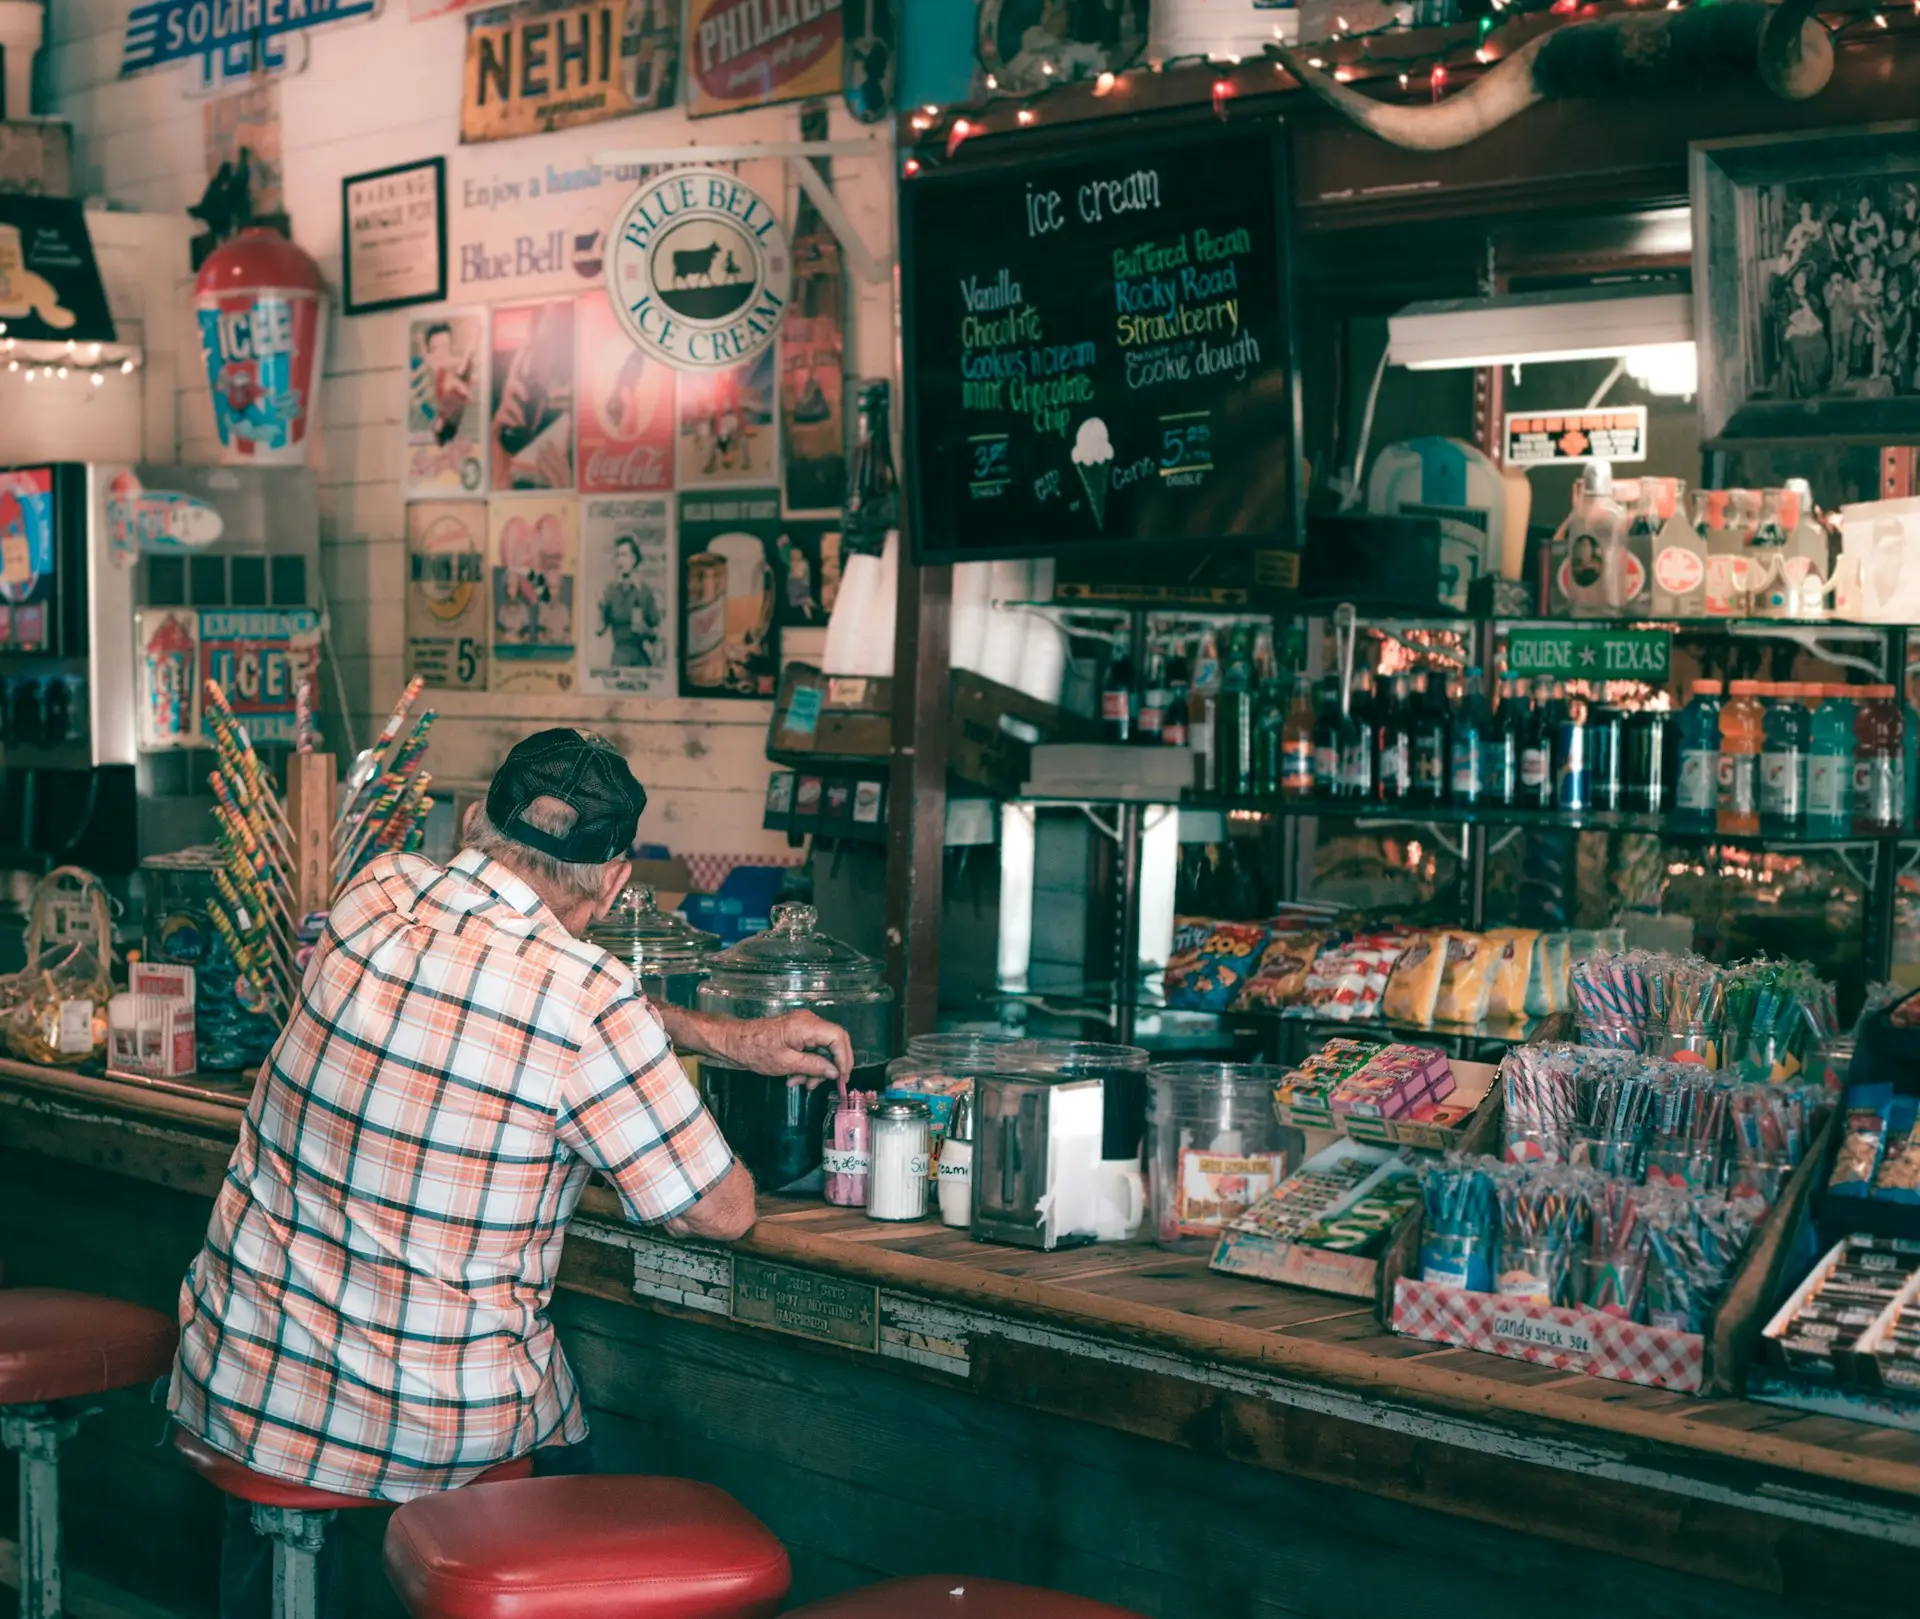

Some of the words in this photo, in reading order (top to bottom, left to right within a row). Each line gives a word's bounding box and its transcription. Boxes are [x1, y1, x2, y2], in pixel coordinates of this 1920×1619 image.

[166, 0, 330, 50] SOUTHE
[701, 0, 843, 73] PHILLI
[477, 9, 611, 106] NEHI
[463, 178, 521, 210] Enjoy
[528, 178, 540, 198] a
[625, 178, 699, 249] BLUE
[707, 179, 775, 248] BELL
[1026, 182, 1064, 237] ice
[1078, 170, 1160, 222] cream
[460, 243, 514, 283] Blue
[515, 231, 565, 275] Bell
[1113, 234, 1188, 279] Buttered
[1194, 228, 1251, 261] Pecan
[960, 268, 1022, 312] Vanilla
[1115, 276, 1177, 320] Rocky
[1181, 260, 1237, 300] Road
[216, 300, 291, 359] ICEE
[631, 296, 680, 351] ICE
[688, 288, 783, 361] CREAM
[1117, 299, 1238, 346] Strawberry
[1195, 329, 1260, 381] dough
[1512, 641, 1572, 669] GRUENE
[1604, 641, 1667, 670] TEXAS
[808, 1299, 853, 1319] NOTHING
[821, 1285, 845, 1300] SITE
